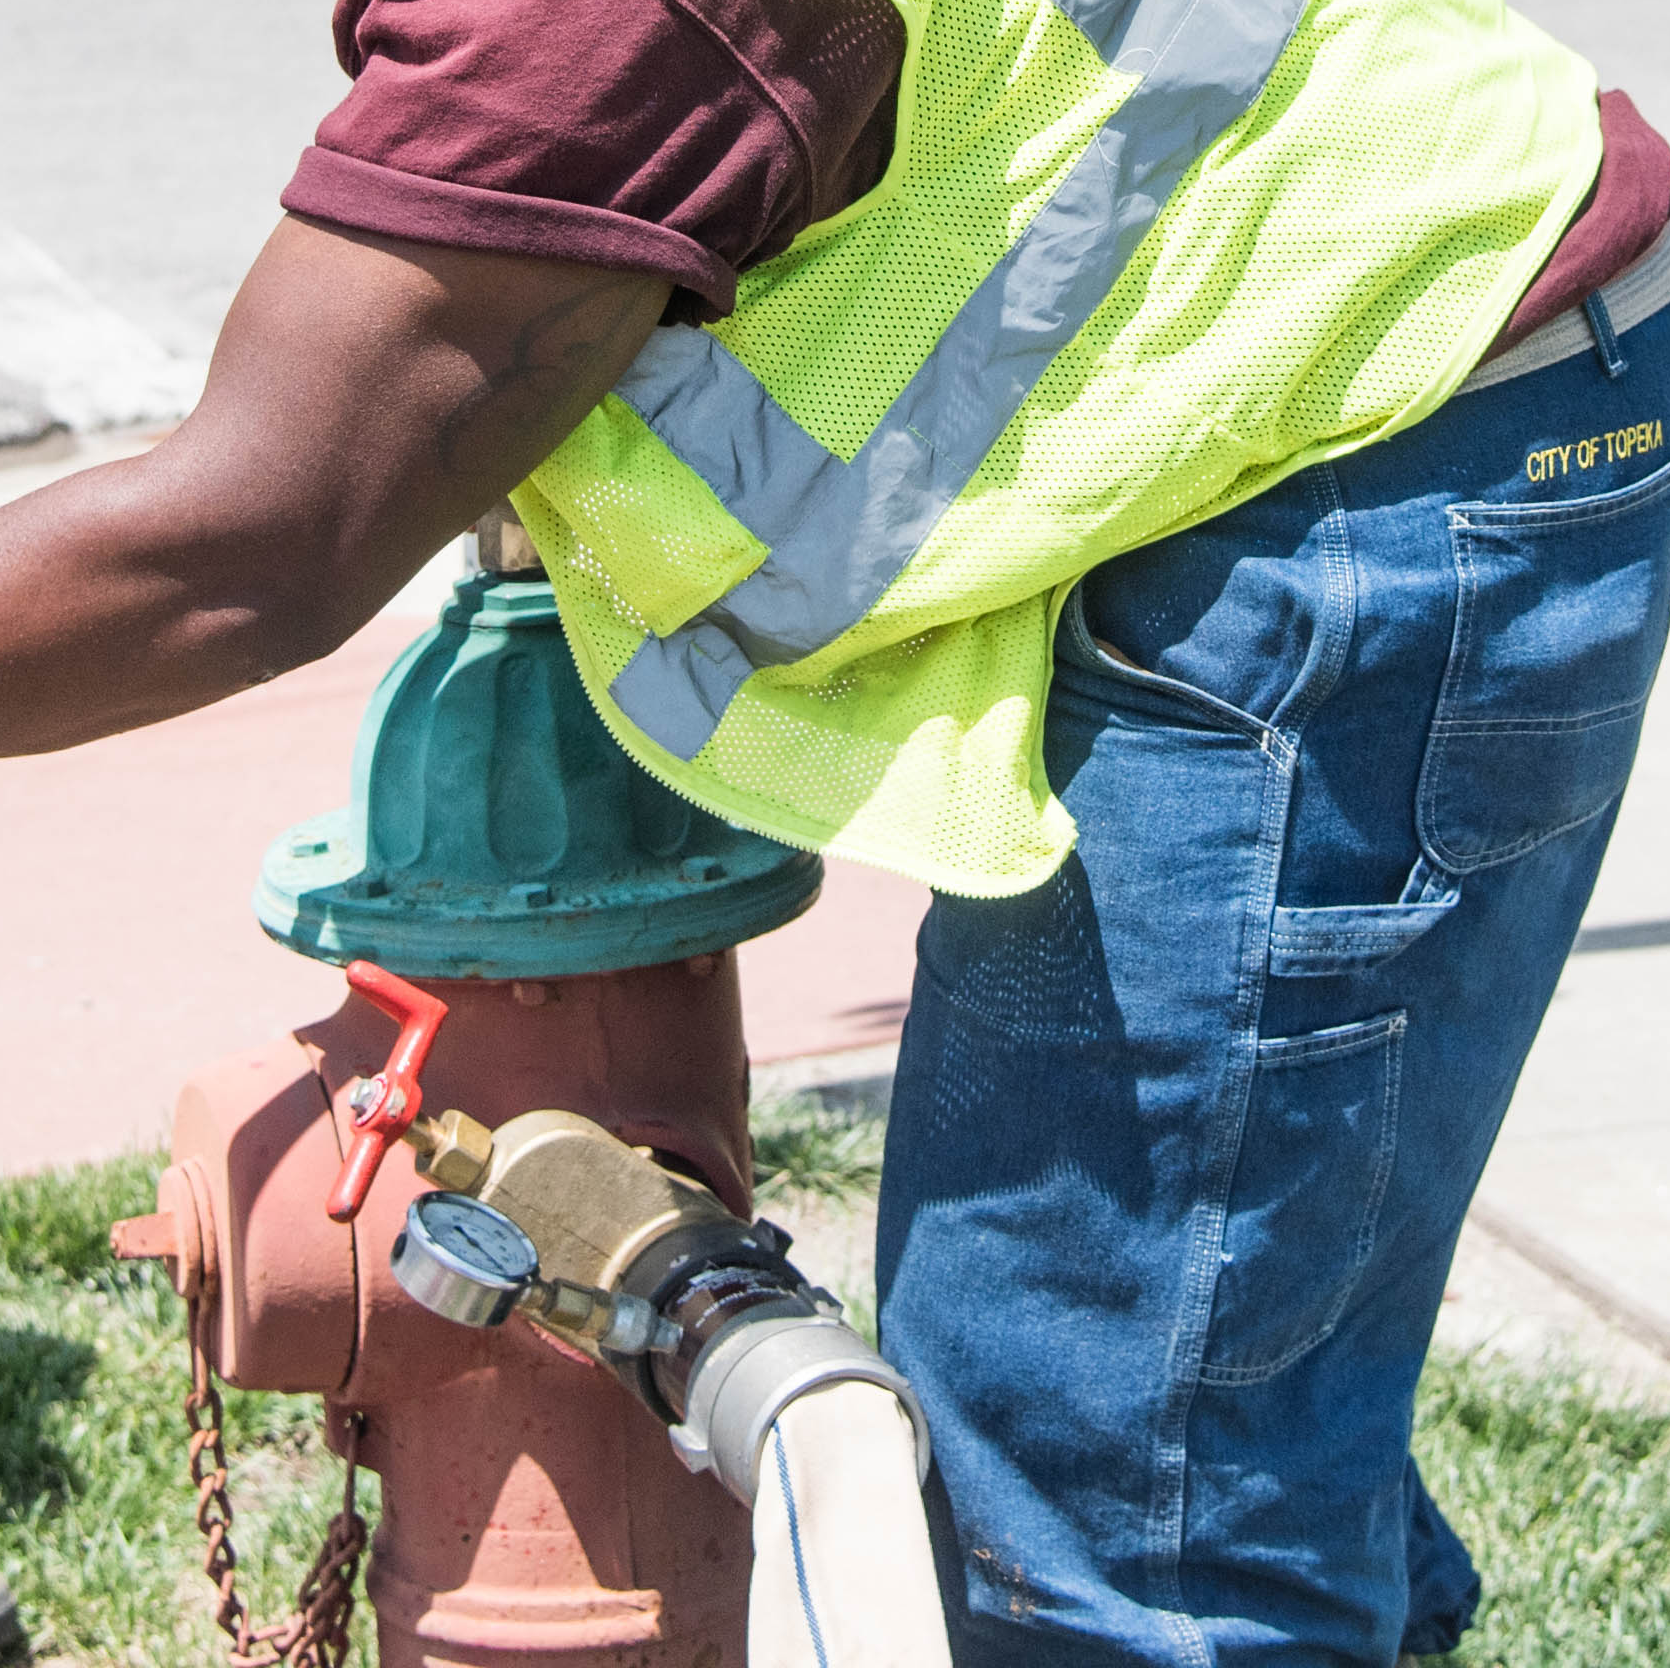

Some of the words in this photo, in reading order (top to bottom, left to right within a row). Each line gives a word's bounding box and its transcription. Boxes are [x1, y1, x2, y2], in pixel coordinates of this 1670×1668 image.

[1526, 444, 1571, 482] CITY
[1577, 437, 1601, 469] OF
[1604, 419, 1664, 463] TOPEKA
